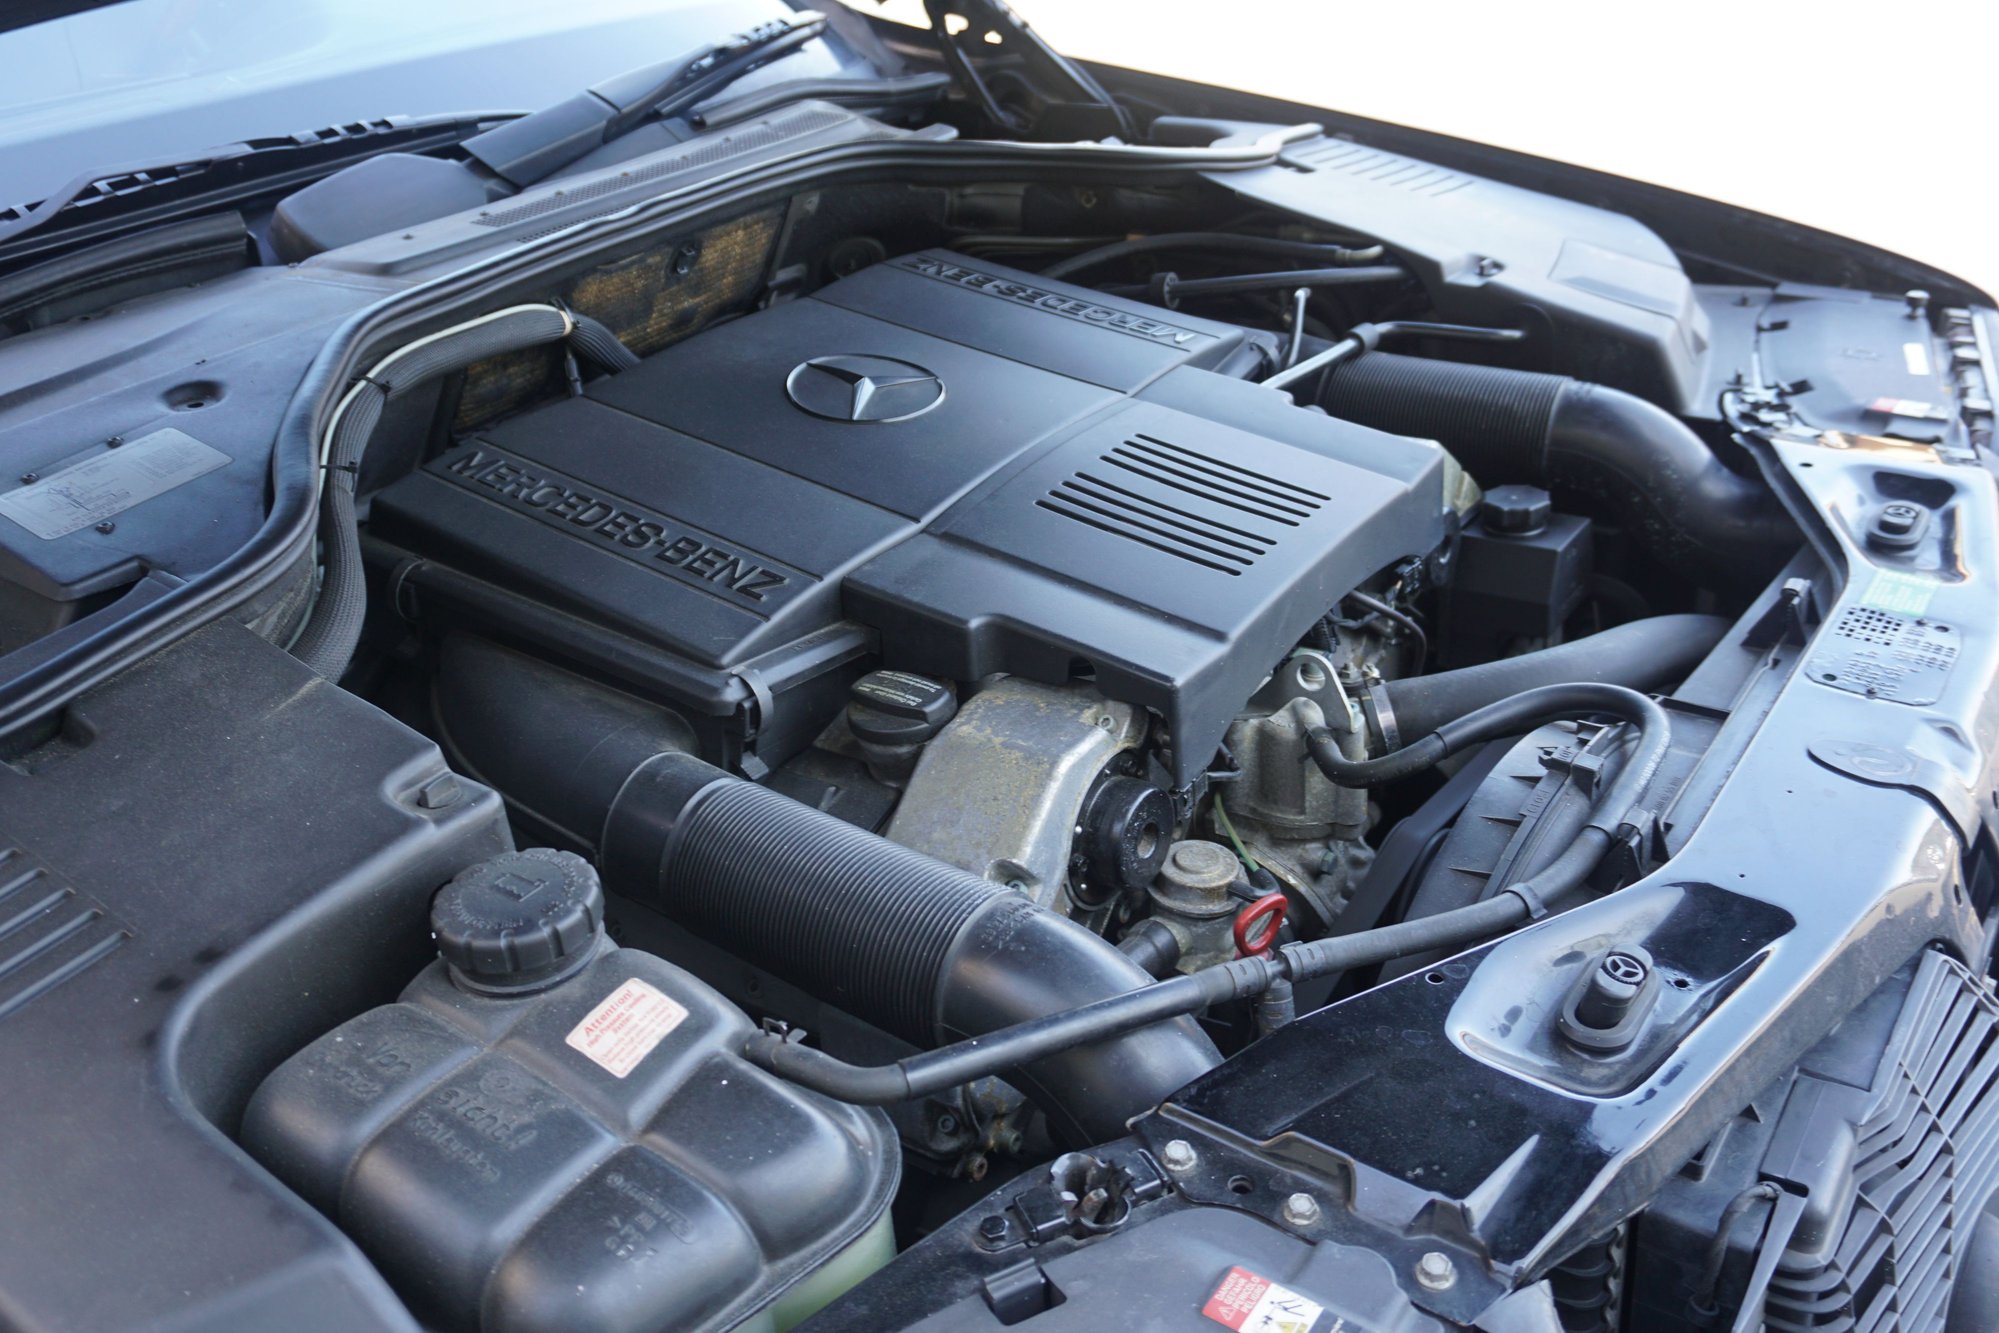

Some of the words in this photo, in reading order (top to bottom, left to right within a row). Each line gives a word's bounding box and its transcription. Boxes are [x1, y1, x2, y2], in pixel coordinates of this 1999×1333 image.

[902, 256, 1197, 345] MERCEDES-BENZ
[448, 450, 790, 601] MERCEDES-BENZ
[583, 989, 634, 1037] Attention!
[1214, 1272, 1240, 1301] DANGER
[1223, 1277, 1248, 1305] GEFAHR
[1231, 1276, 1262, 1310] PERICOLO
[1240, 1283, 1267, 1314] PELIGRO
